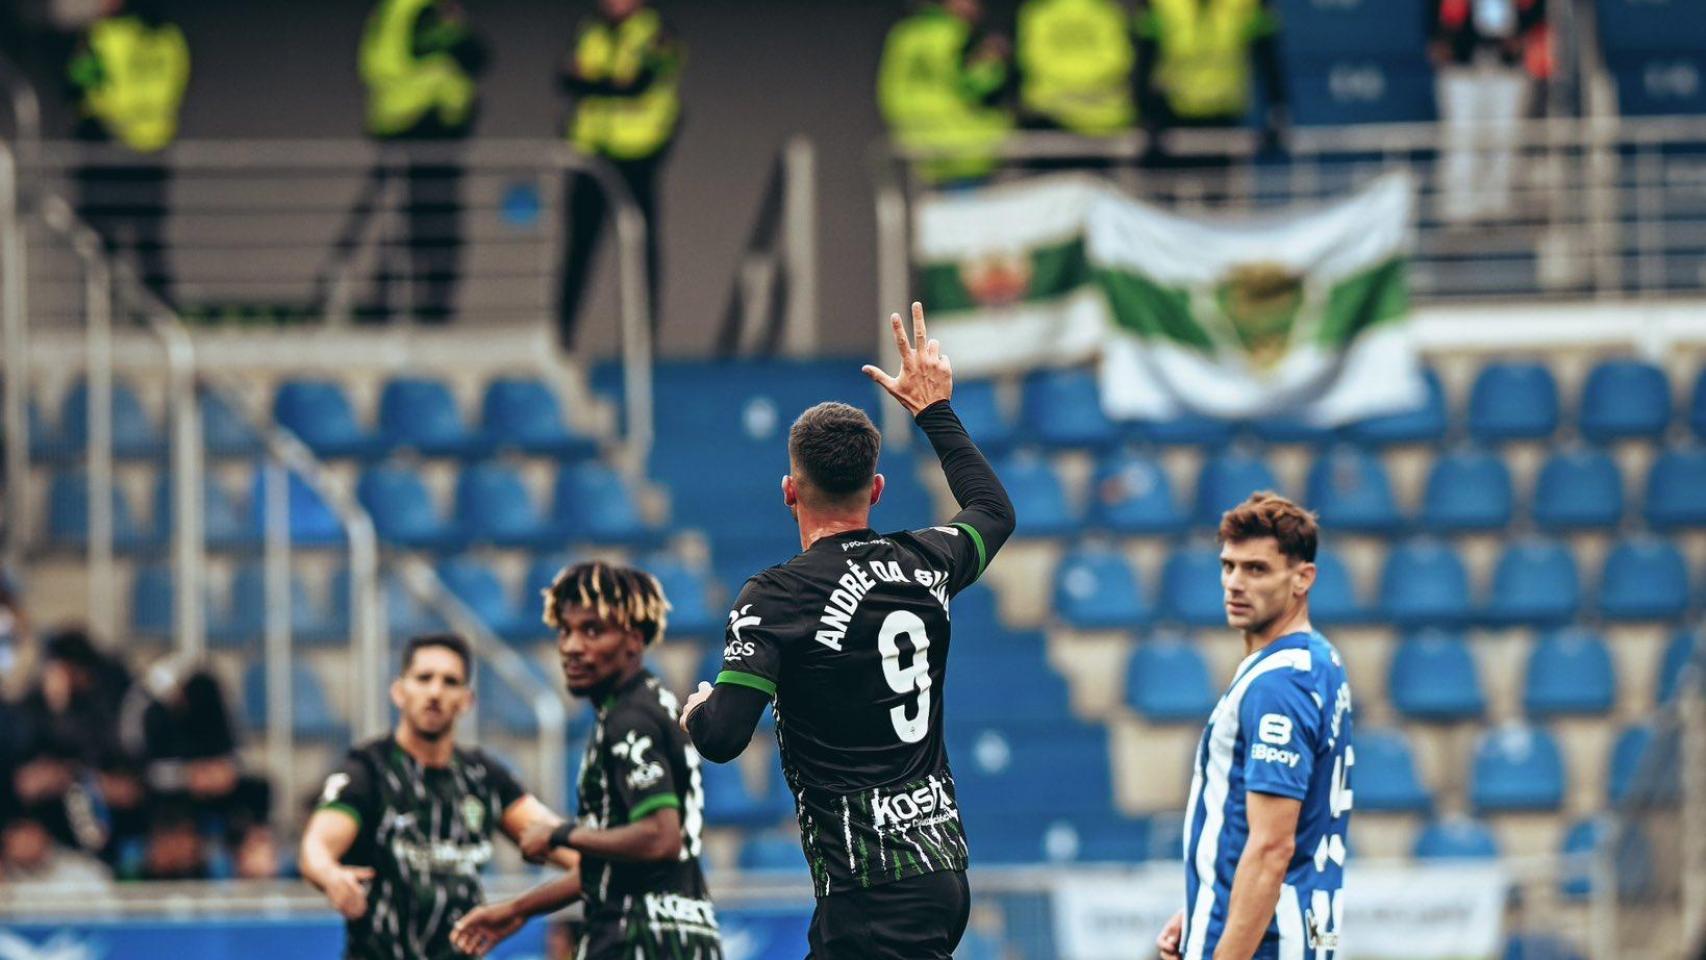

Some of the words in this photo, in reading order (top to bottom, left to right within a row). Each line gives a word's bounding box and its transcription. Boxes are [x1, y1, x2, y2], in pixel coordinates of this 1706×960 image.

[814, 558, 877, 652] ANDRÉ
[869, 560, 912, 583] DA
[878, 609, 932, 744] 9
